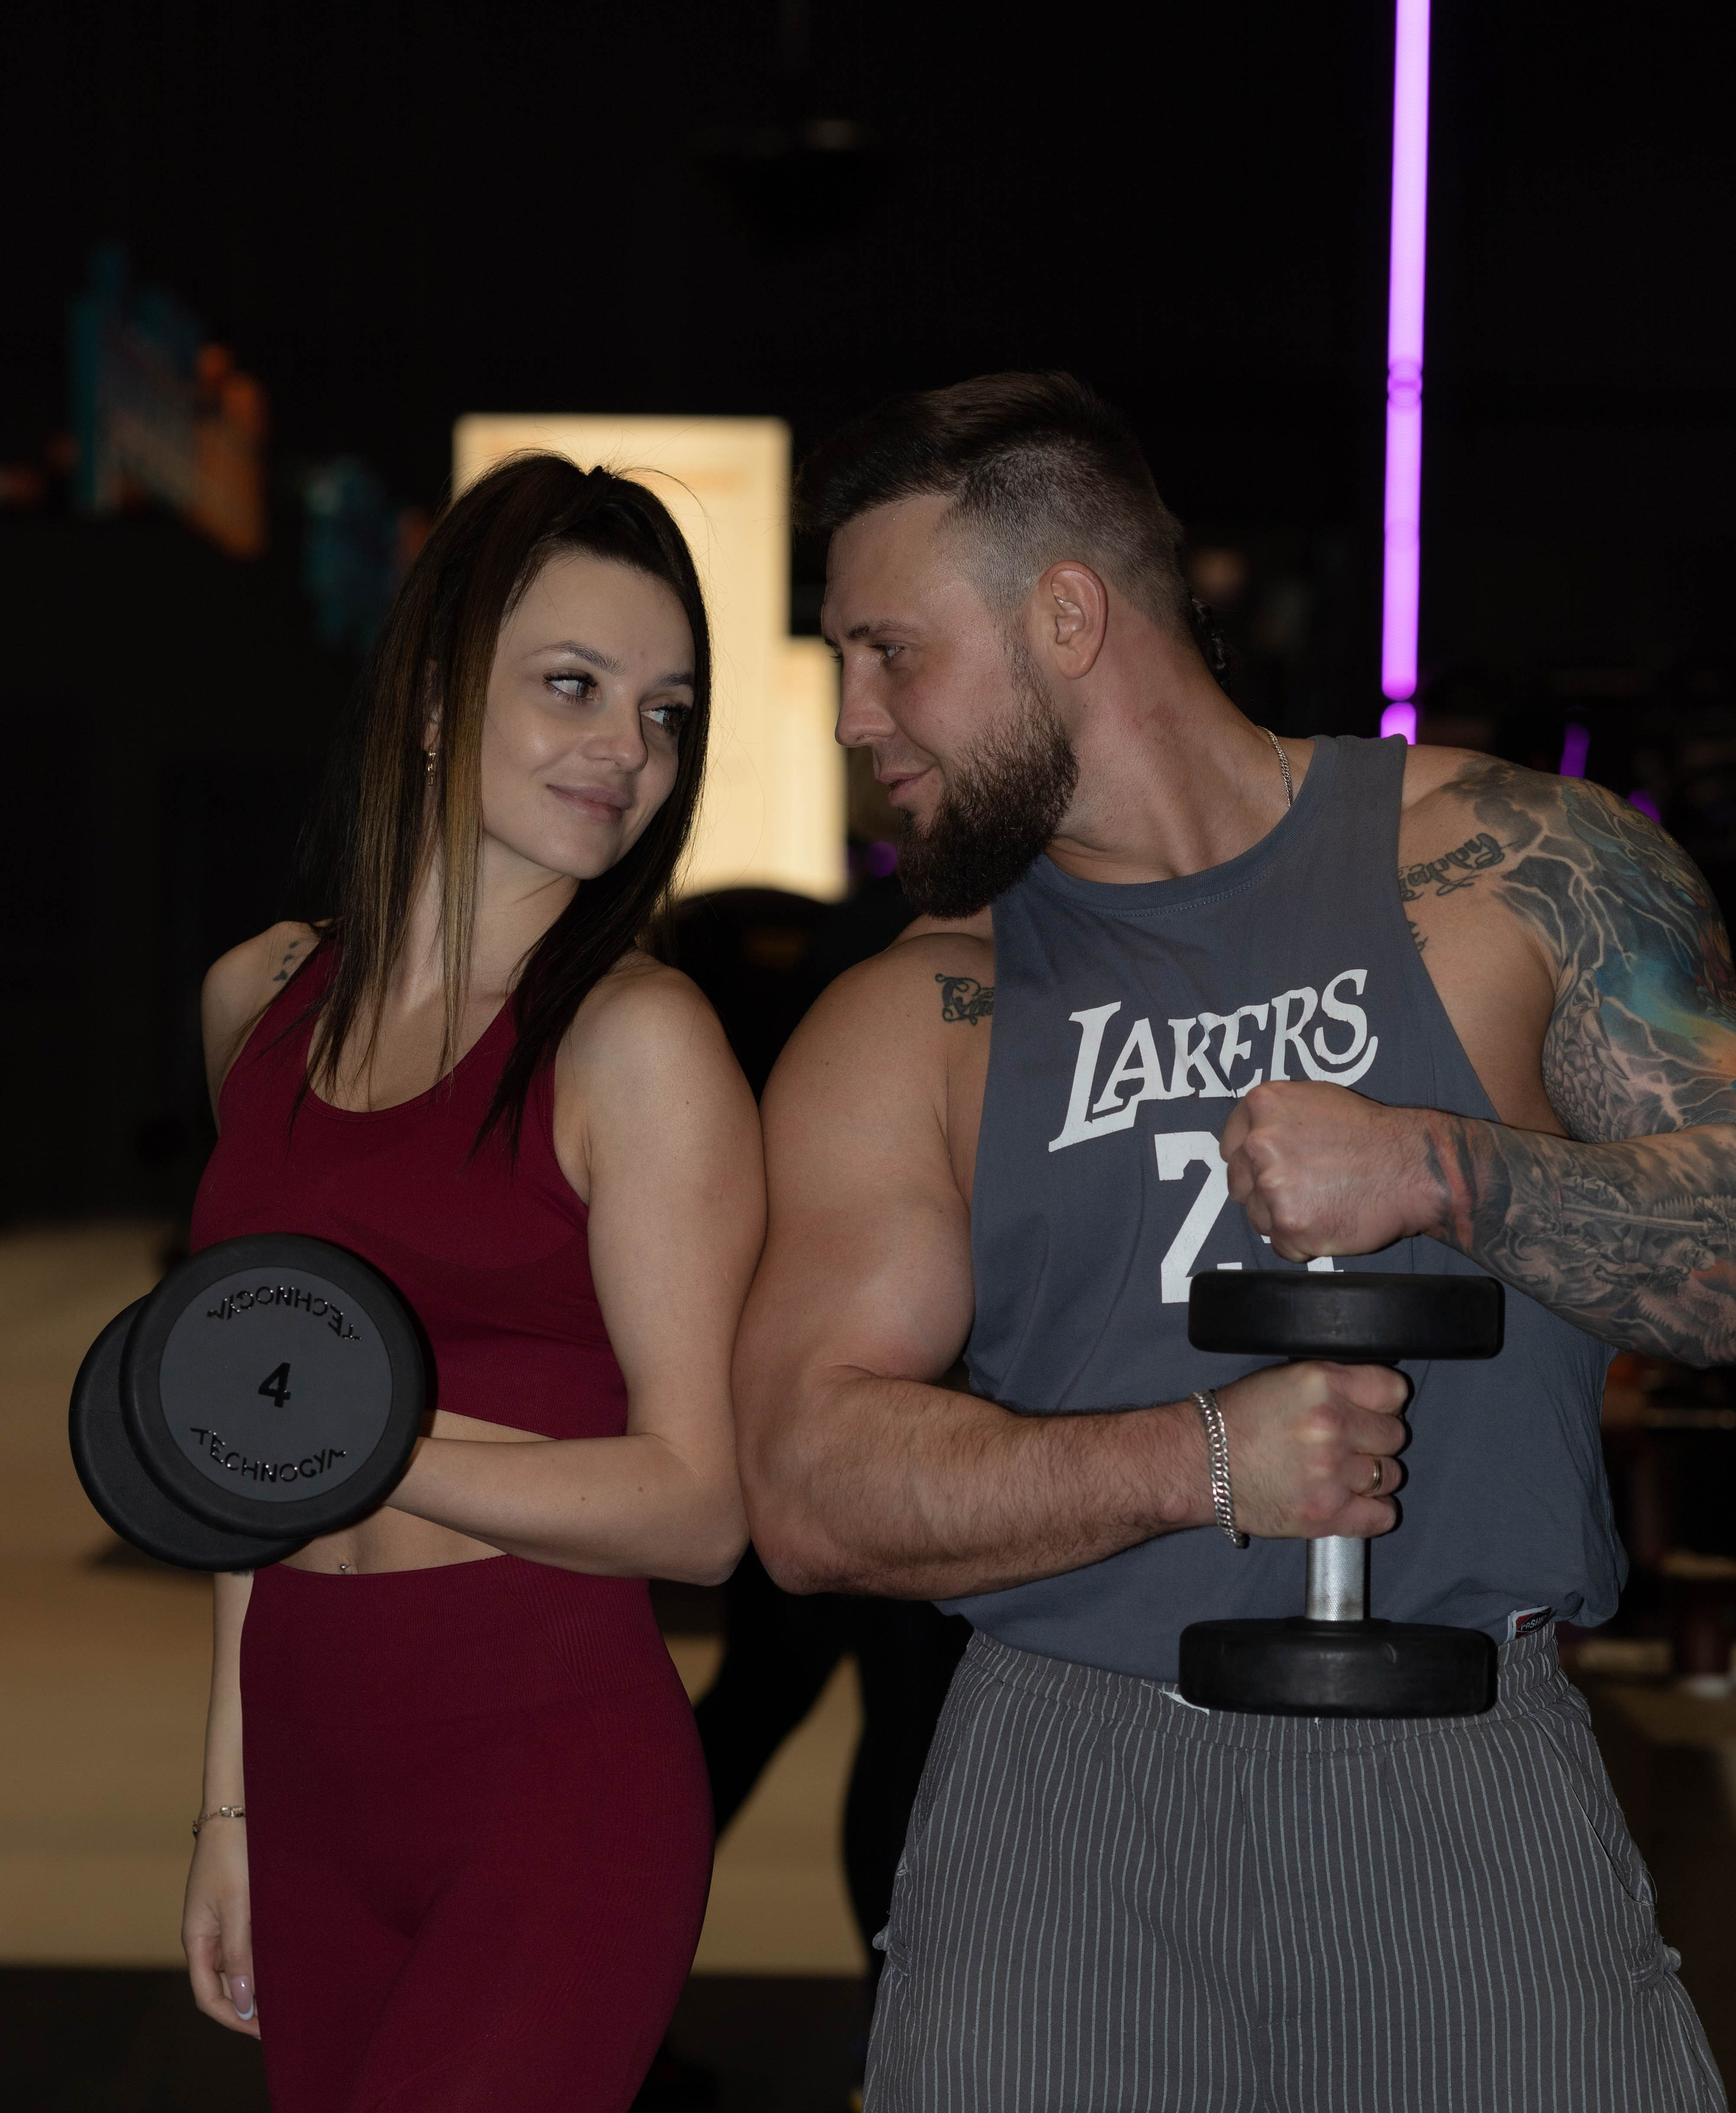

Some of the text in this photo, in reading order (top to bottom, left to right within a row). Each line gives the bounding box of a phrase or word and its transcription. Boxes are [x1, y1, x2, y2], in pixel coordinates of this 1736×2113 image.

[1048, 969, 1379, 1153] LAKERS
[1154, 1131, 1343, 1303] 2
[206, 1286, 362, 1341] TECHNOGYM
[258, 1362, 291, 1408] 4
[190, 1427, 347, 1483] TECHNOGYM
